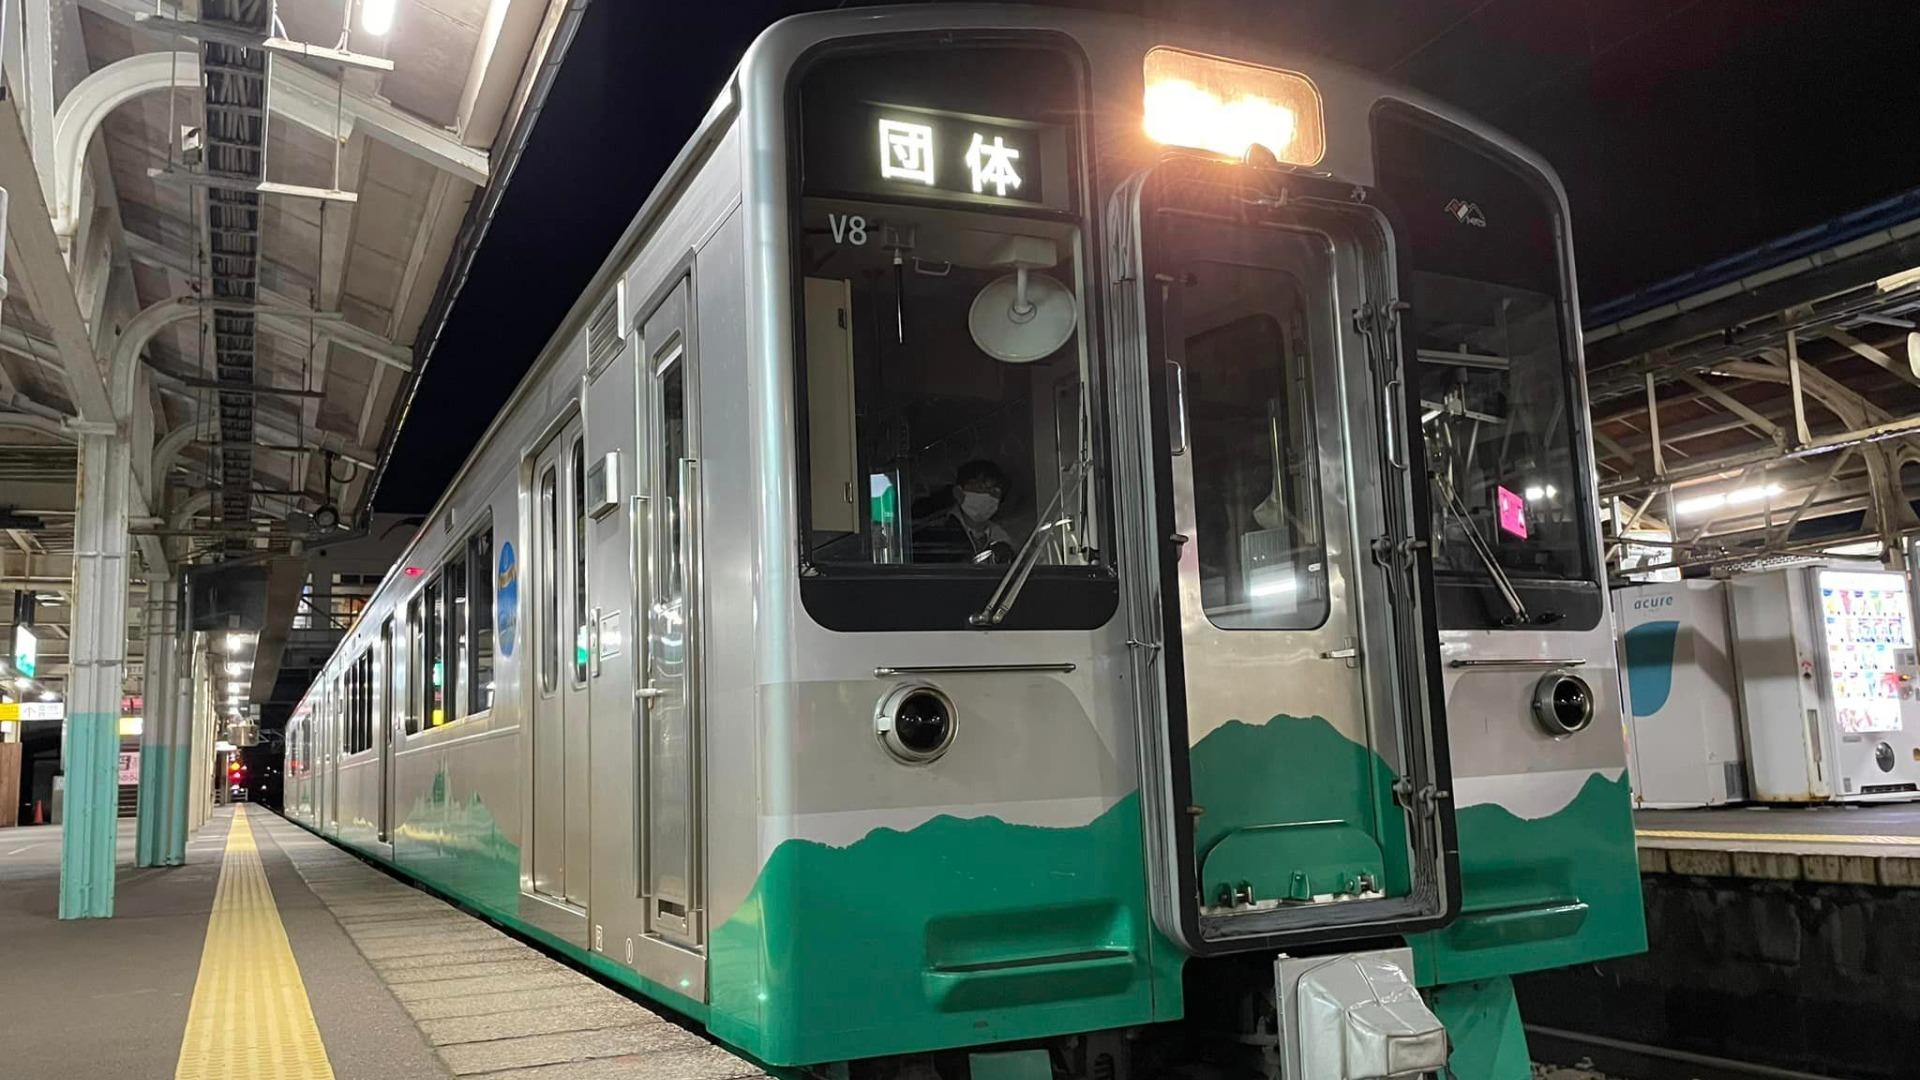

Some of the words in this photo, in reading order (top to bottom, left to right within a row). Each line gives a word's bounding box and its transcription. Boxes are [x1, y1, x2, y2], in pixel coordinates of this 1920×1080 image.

[878, 118, 1022, 196] 団体
[828, 213, 867, 245] V8
[1634, 596, 1673, 610] acure
